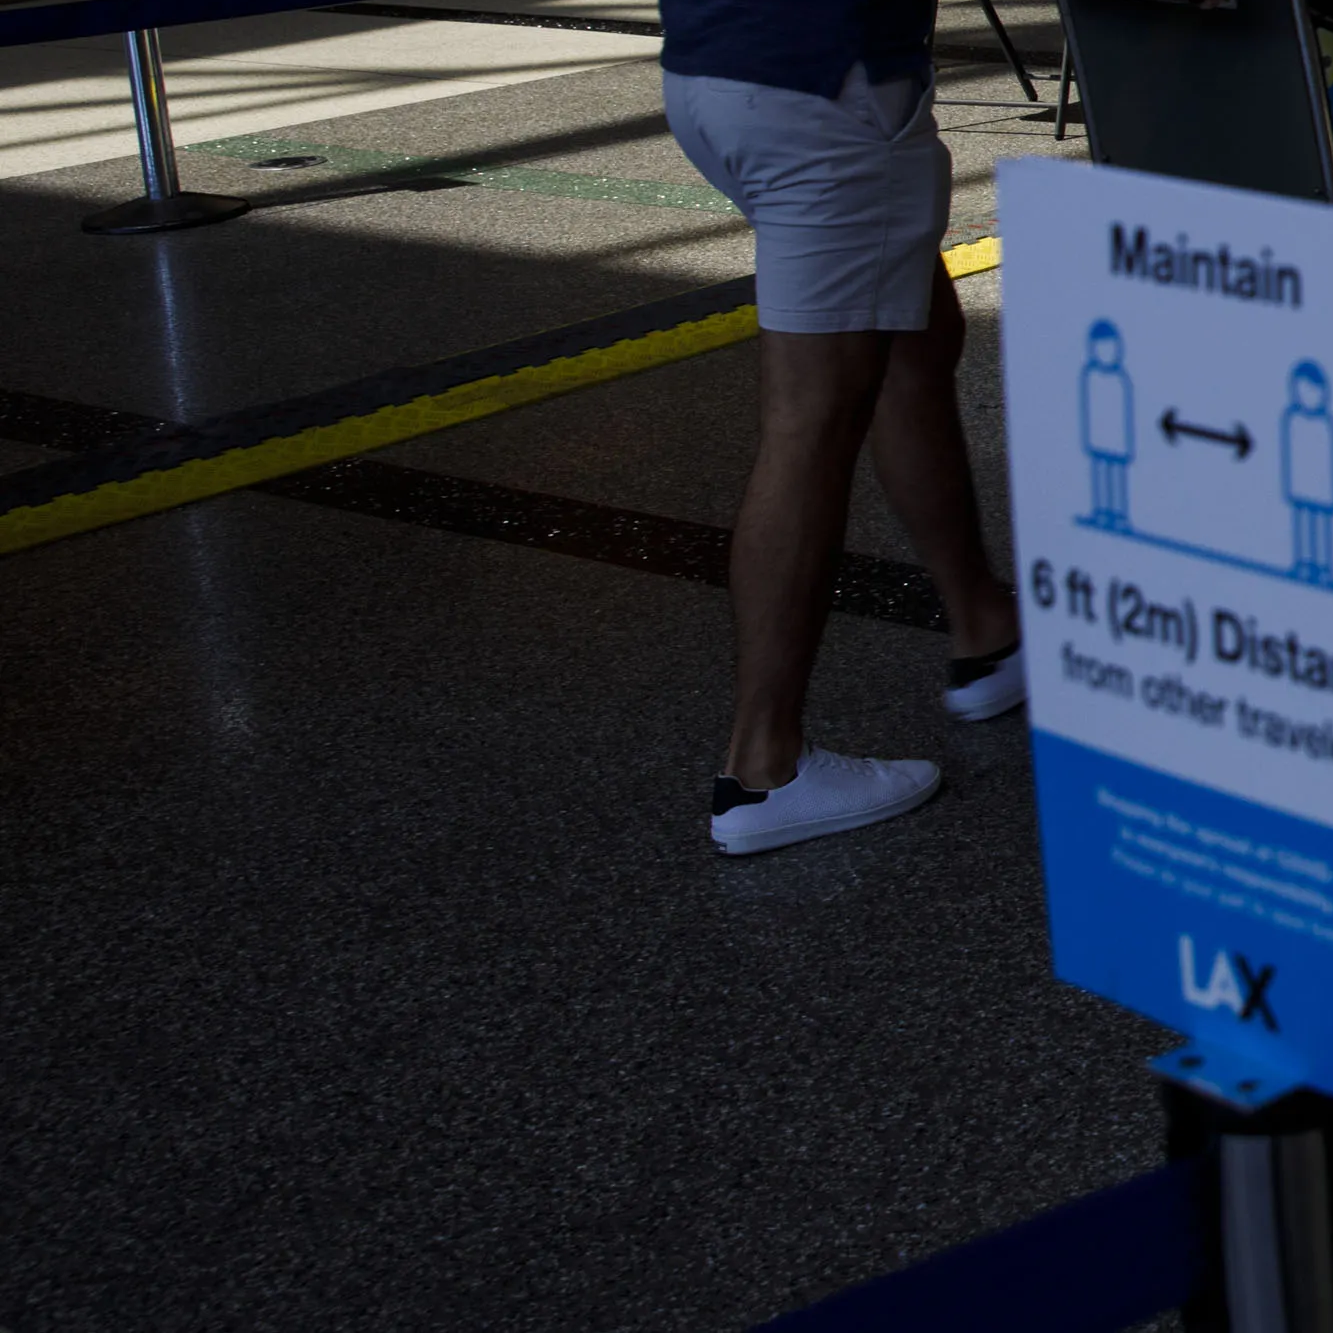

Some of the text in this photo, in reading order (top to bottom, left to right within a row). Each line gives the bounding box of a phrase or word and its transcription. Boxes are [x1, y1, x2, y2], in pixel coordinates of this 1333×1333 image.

[1109, 220, 1304, 308] Maintain
[1032, 558, 1056, 609] 6
[1066, 568, 1097, 622] ft
[1108, 577, 1198, 660] (2m)
[1061, 640, 1134, 701] from
[1140, 672, 1226, 728] other
[1177, 932, 1280, 1032] LAX
